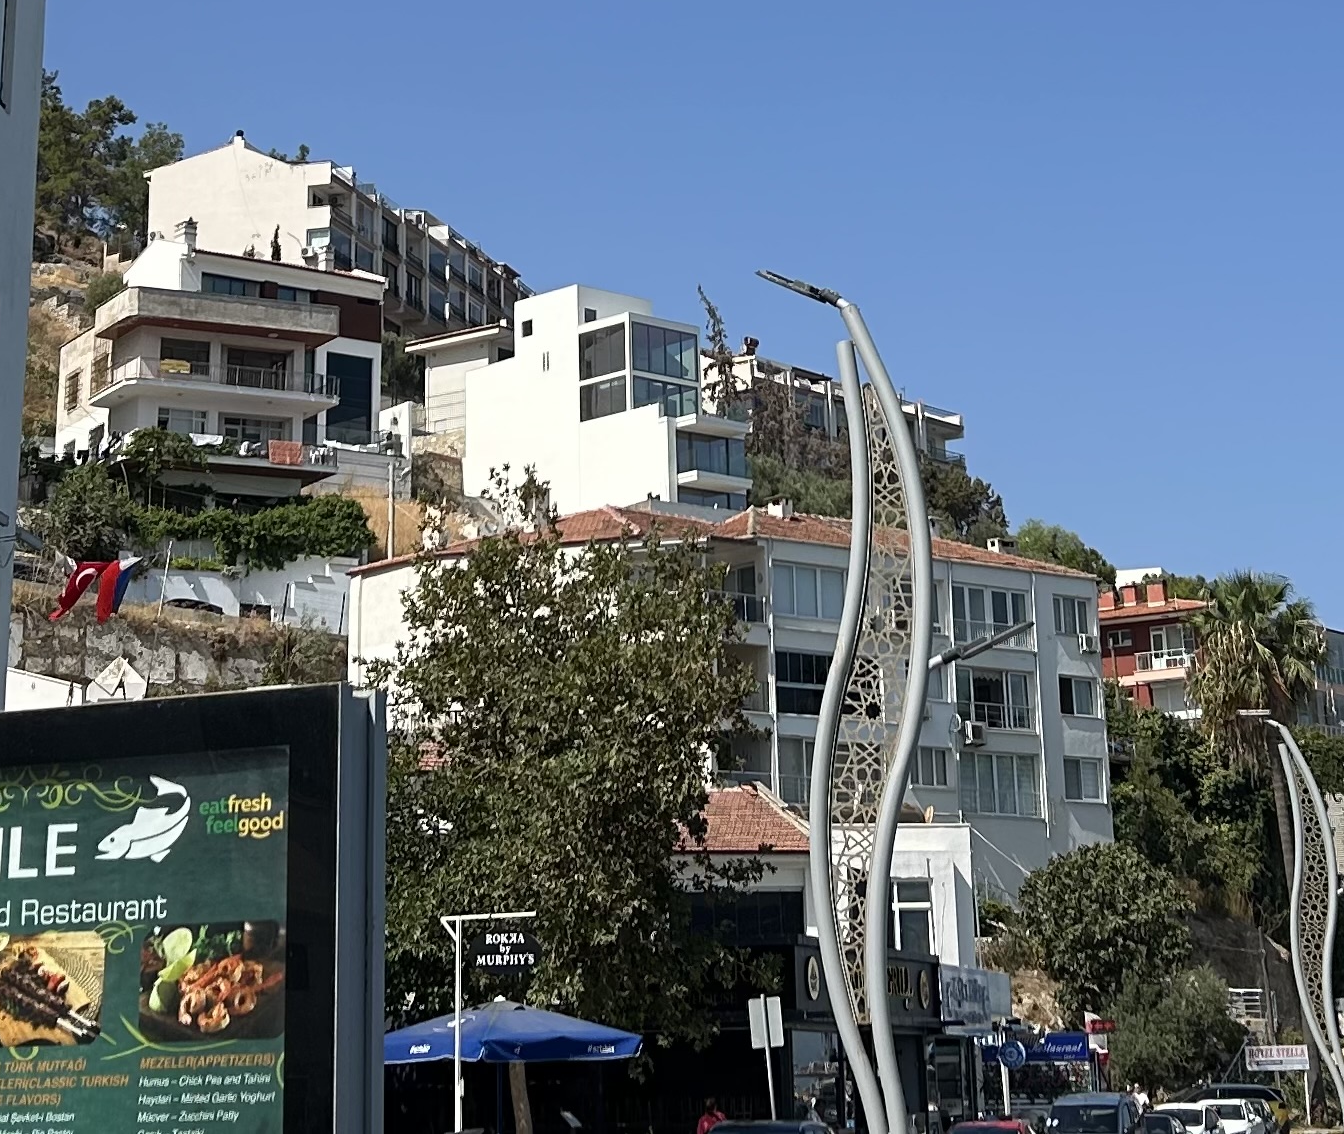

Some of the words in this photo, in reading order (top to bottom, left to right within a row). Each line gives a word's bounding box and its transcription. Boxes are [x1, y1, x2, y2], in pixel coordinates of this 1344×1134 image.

[21, 895, 168, 926] Restaurant
[499, 944, 512, 955] by
[1276, 1047, 1306, 1059] STELLA
[80, 1074, 130, 1088] TURKISH
